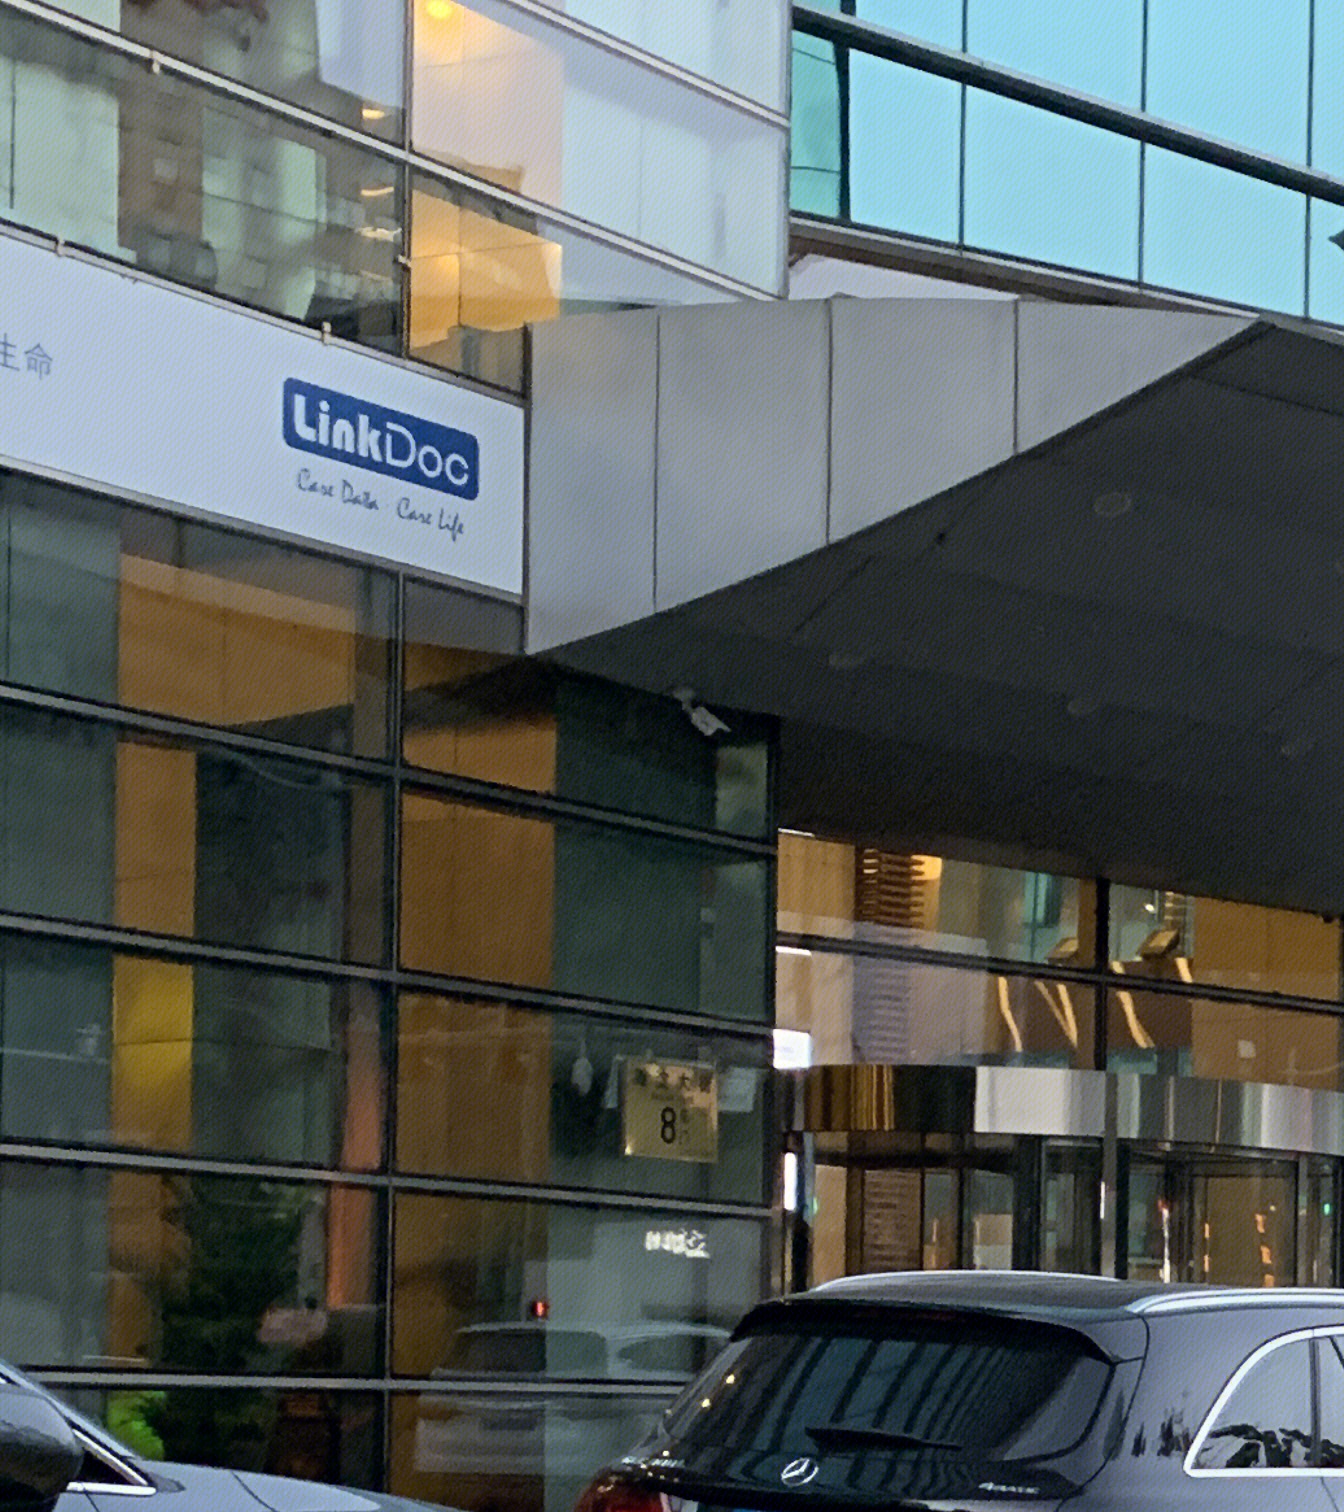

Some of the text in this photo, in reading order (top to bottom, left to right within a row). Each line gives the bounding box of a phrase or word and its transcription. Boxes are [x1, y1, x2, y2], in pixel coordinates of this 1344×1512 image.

[294, 393, 469, 486] LinkDoc
[342, 479, 379, 510] Data
[438, 507, 464, 542] Life
[661, 1106, 676, 1145] 8
